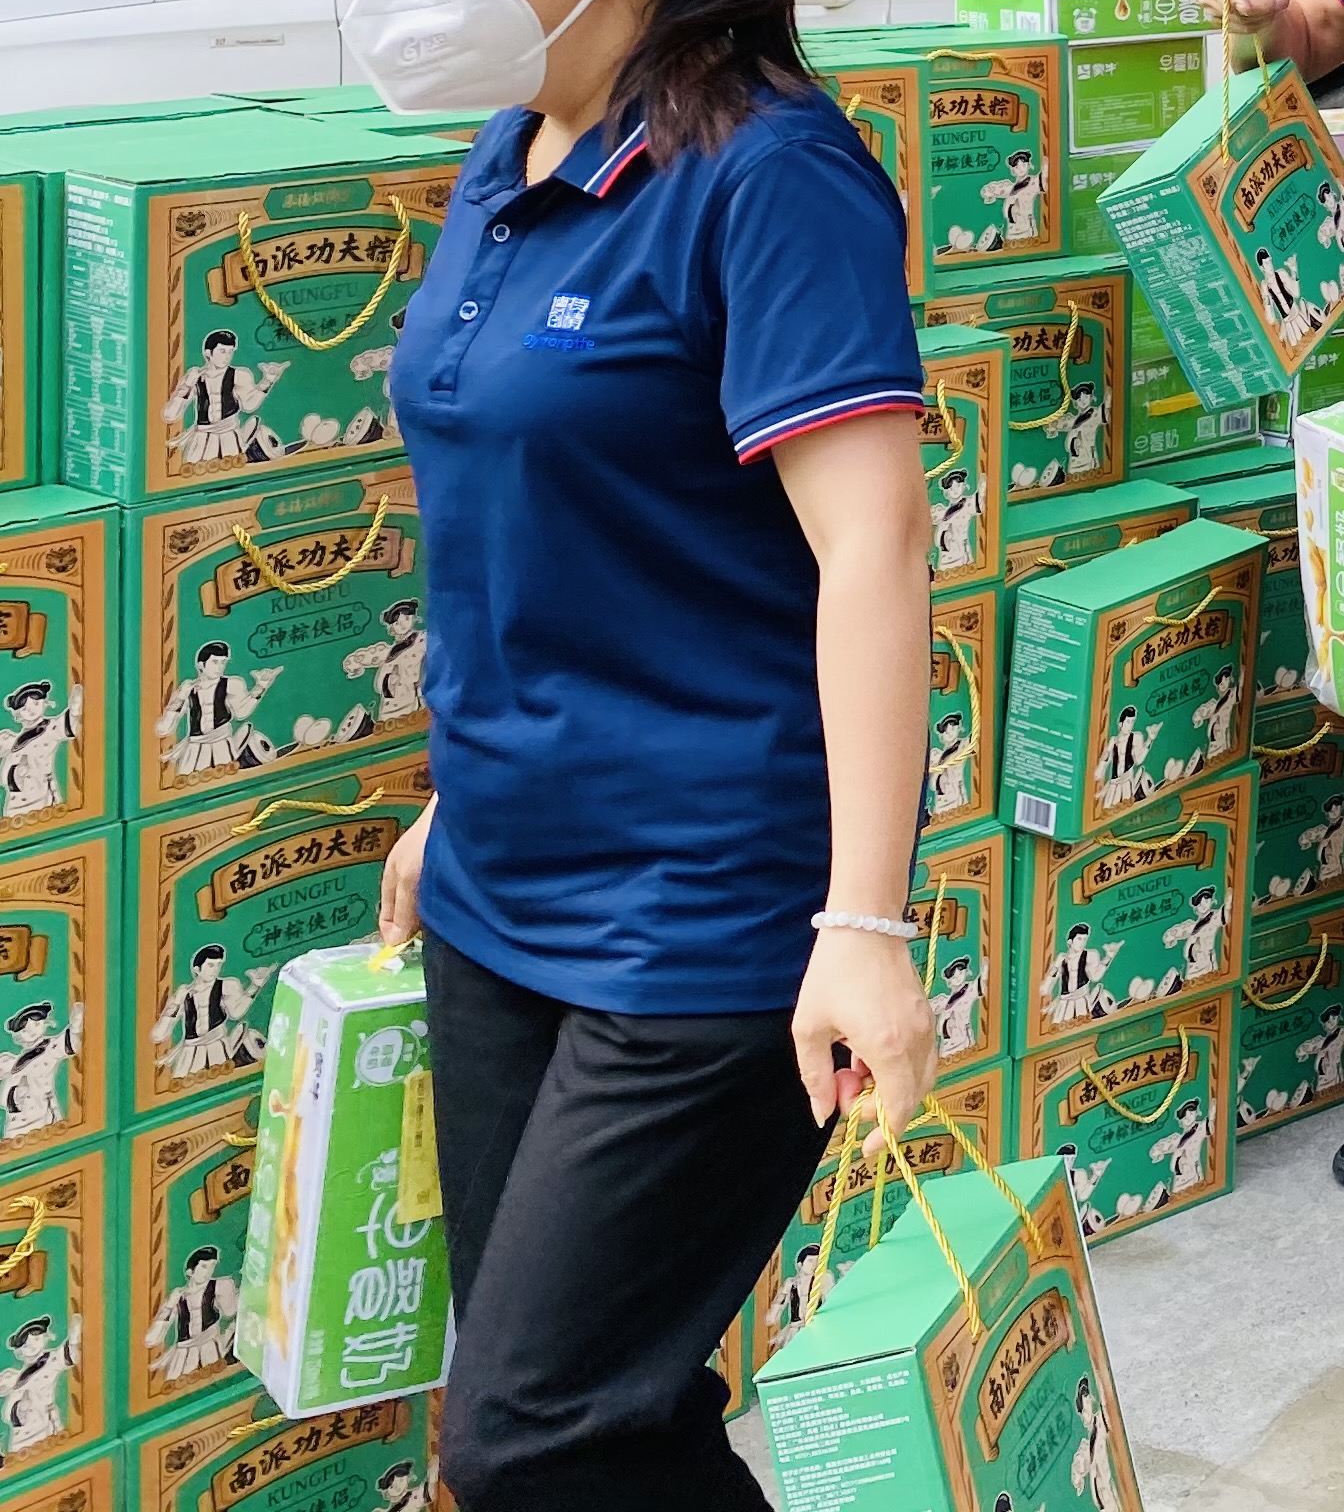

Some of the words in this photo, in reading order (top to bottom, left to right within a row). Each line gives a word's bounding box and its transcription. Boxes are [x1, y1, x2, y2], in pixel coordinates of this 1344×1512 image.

[931, 129, 987, 147] KUNGFU
[1239, 141, 1297, 209] 南派功夫粽
[278, 281, 360, 307] KUNGFU
[270, 581, 350, 614] KUNGFU
[265, 612, 355, 650] 神粽侠侣
[1141, 615, 1222, 667] 南派功夫粽
[1158, 653, 1201, 682] KUNGFU
[229, 825, 385, 894] 南派功夫粽
[1094, 837, 1198, 885] 南派功夫粽
[265, 874, 348, 914] KUNGFU
[1117, 874, 1172, 901] KUNGFU
[262, 904, 350, 948] 神粽侠侣
[989, 1301, 1060, 1420] 南派功夫粽
[228, 1403, 385, 1494] 南派功夫粽
[267, 1457, 347, 1508] KUNGFU
